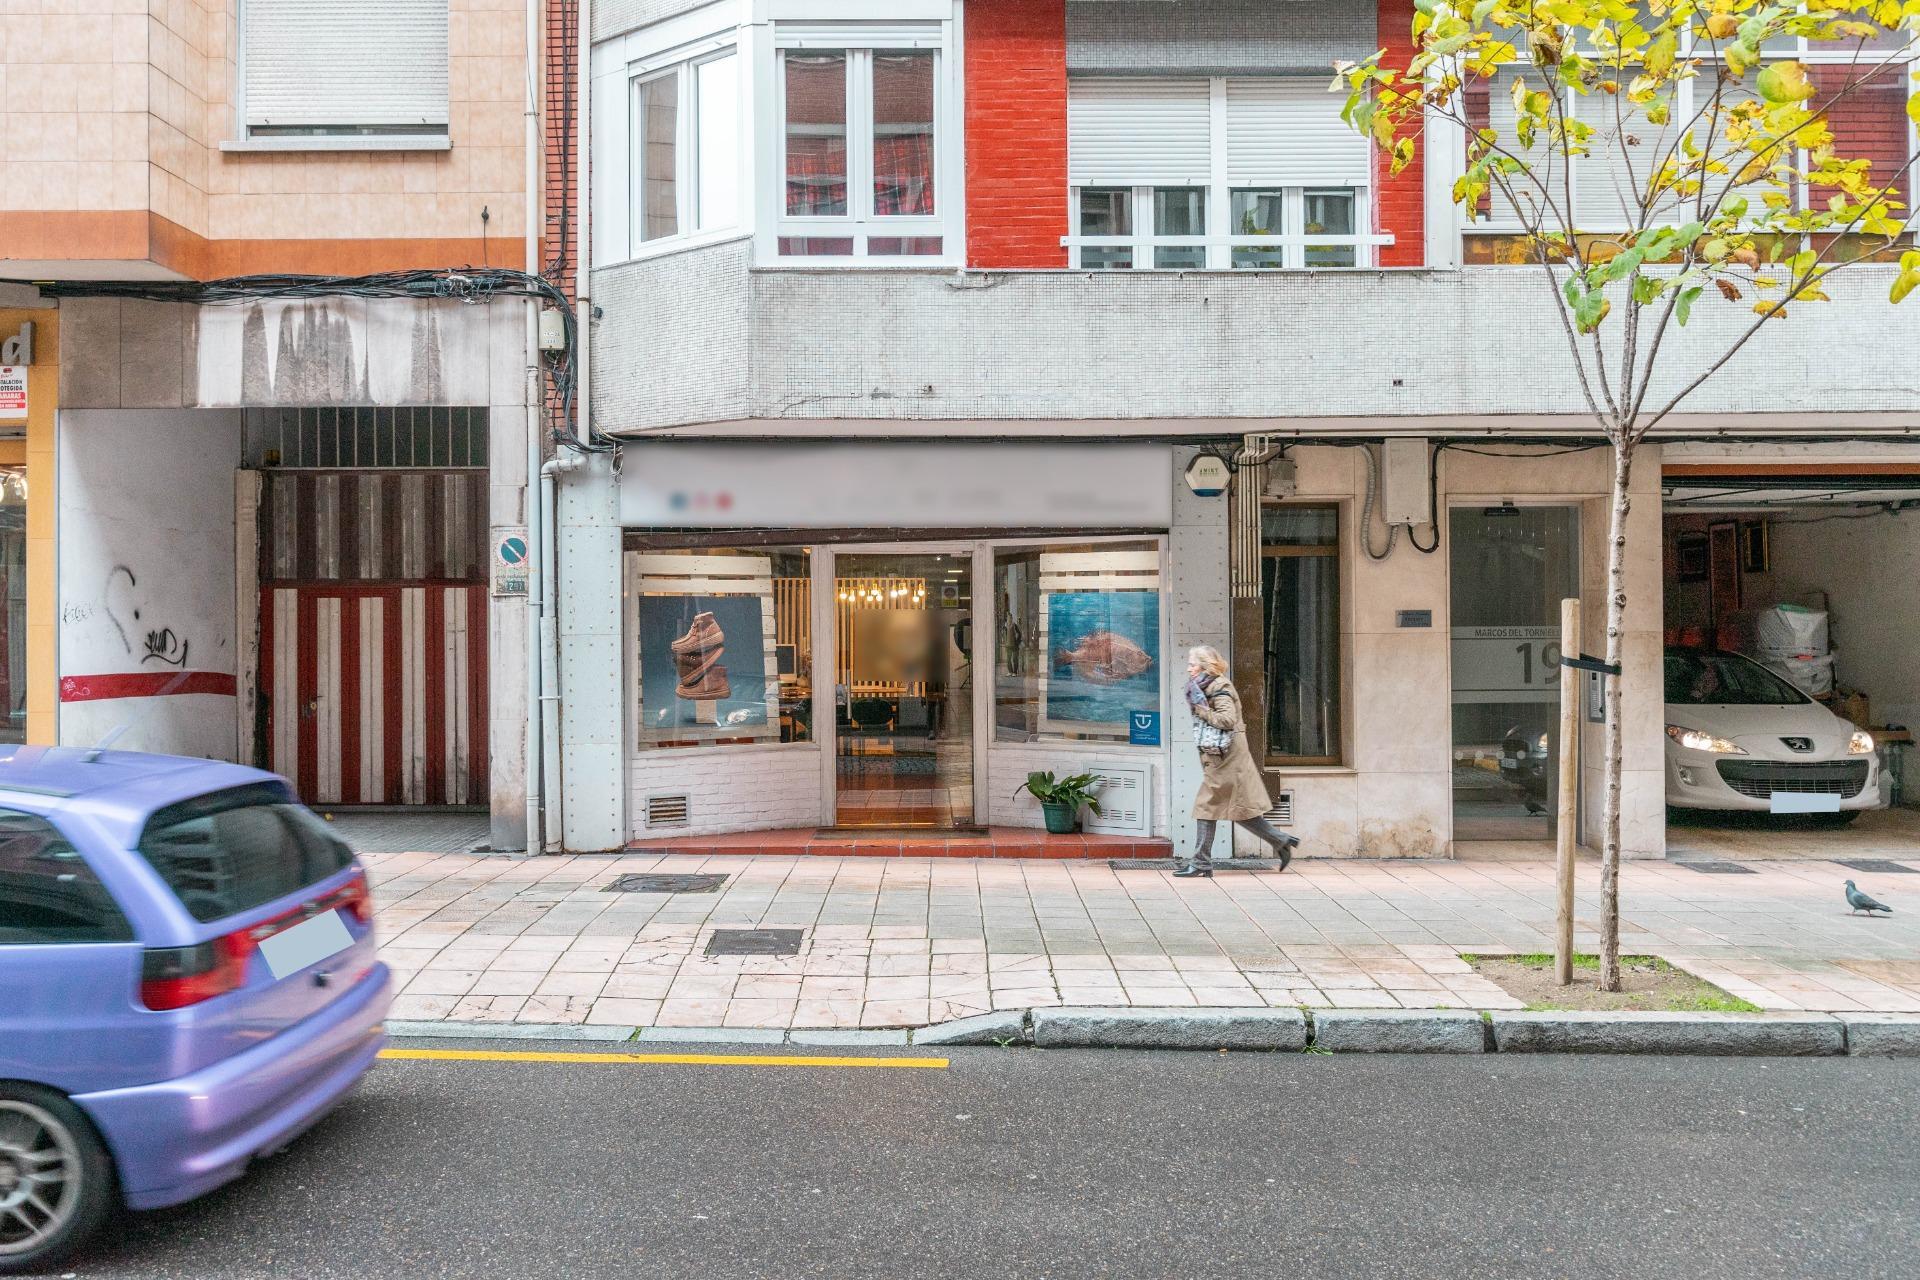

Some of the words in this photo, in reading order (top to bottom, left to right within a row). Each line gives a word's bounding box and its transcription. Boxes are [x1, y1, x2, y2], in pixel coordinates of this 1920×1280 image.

[1474, 628, 1508, 637] MARCOS
[1508, 628, 1523, 637] DEL
[1515, 642, 1562, 685] 19
